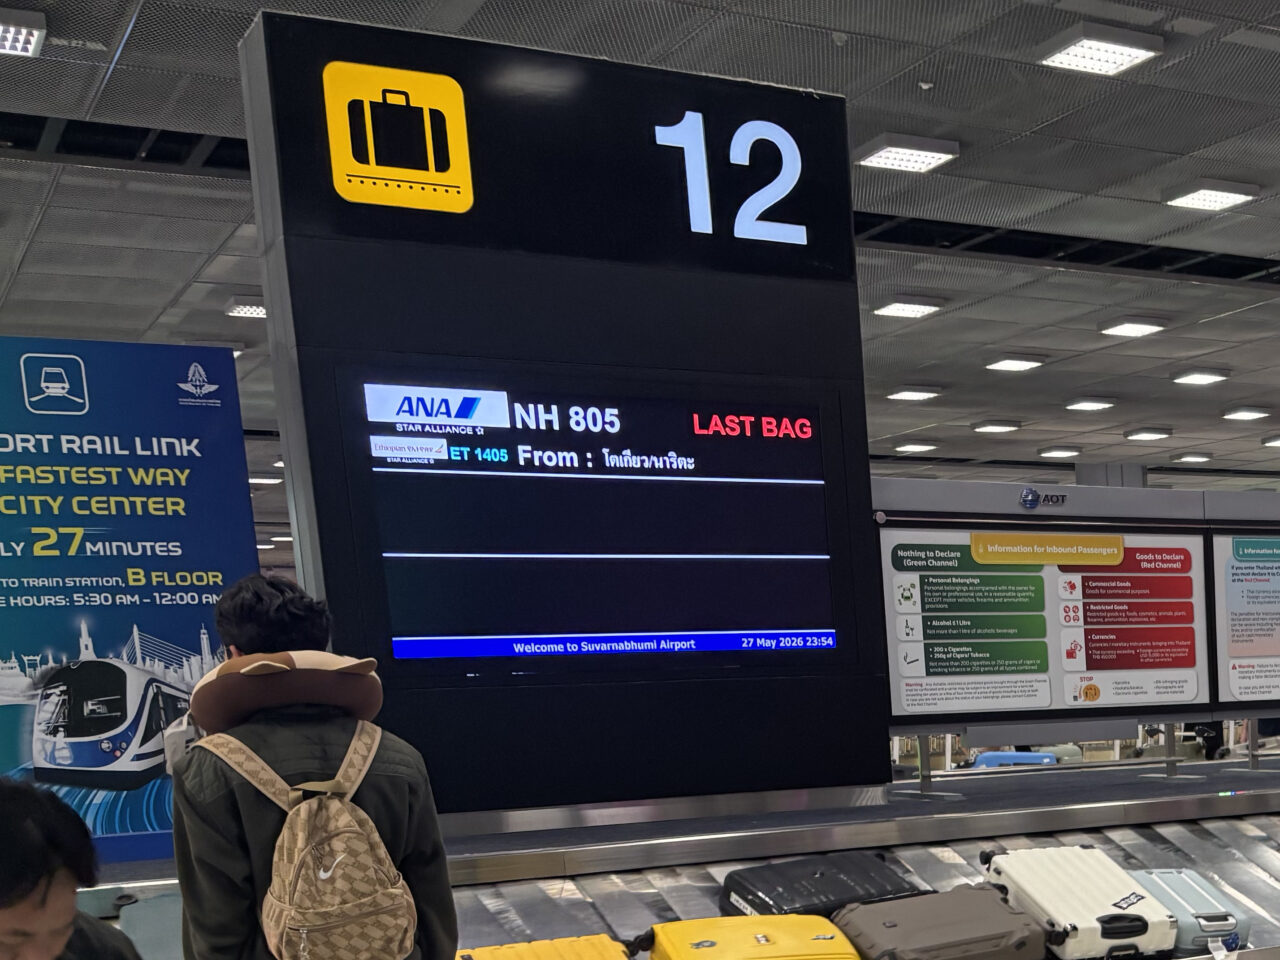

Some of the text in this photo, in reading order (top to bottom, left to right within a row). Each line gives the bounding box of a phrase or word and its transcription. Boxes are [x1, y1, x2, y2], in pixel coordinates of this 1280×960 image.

[654, 110, 808, 245] 12
[395, 396, 453, 418] ANA
[513, 402, 621, 434] NH 805
[693, 413, 812, 439] LAST BAG
[396, 423, 474, 435] STAR ALLIANCE
[60, 435, 129, 455] RAIL
[134, 436, 201, 457] LINK
[450, 446, 470, 461] ET
[474, 447, 509, 462] 1405
[517, 445, 578, 467] From
[0, 465, 191, 486] FASTEST WAY
[0, 495, 187, 516] CITY CENTER
[1042, 494, 1067, 504] AOT
[31, 527, 85, 556] 27
[85, 541, 183, 556] MINUTES
[987, 543, 1118, 556] Information for Inbound Passengers
[897, 550, 926, 558] Nothing
[935, 550, 961, 558] Declare
[903, 559, 958, 567] (Green Channel)
[0, 568, 224, 588] TO TRAIN STATION, B FLOOR
[10, 595, 70, 606] HOURS:
[73, 593, 113, 606] 5:30
[116, 595, 140, 605] AM
[153, 592, 199, 605] 12:00
[513, 639, 696, 653] Welcome to Suvarnabhumi Airport
[741, 636, 834, 649] 27 May 2026 23:54
